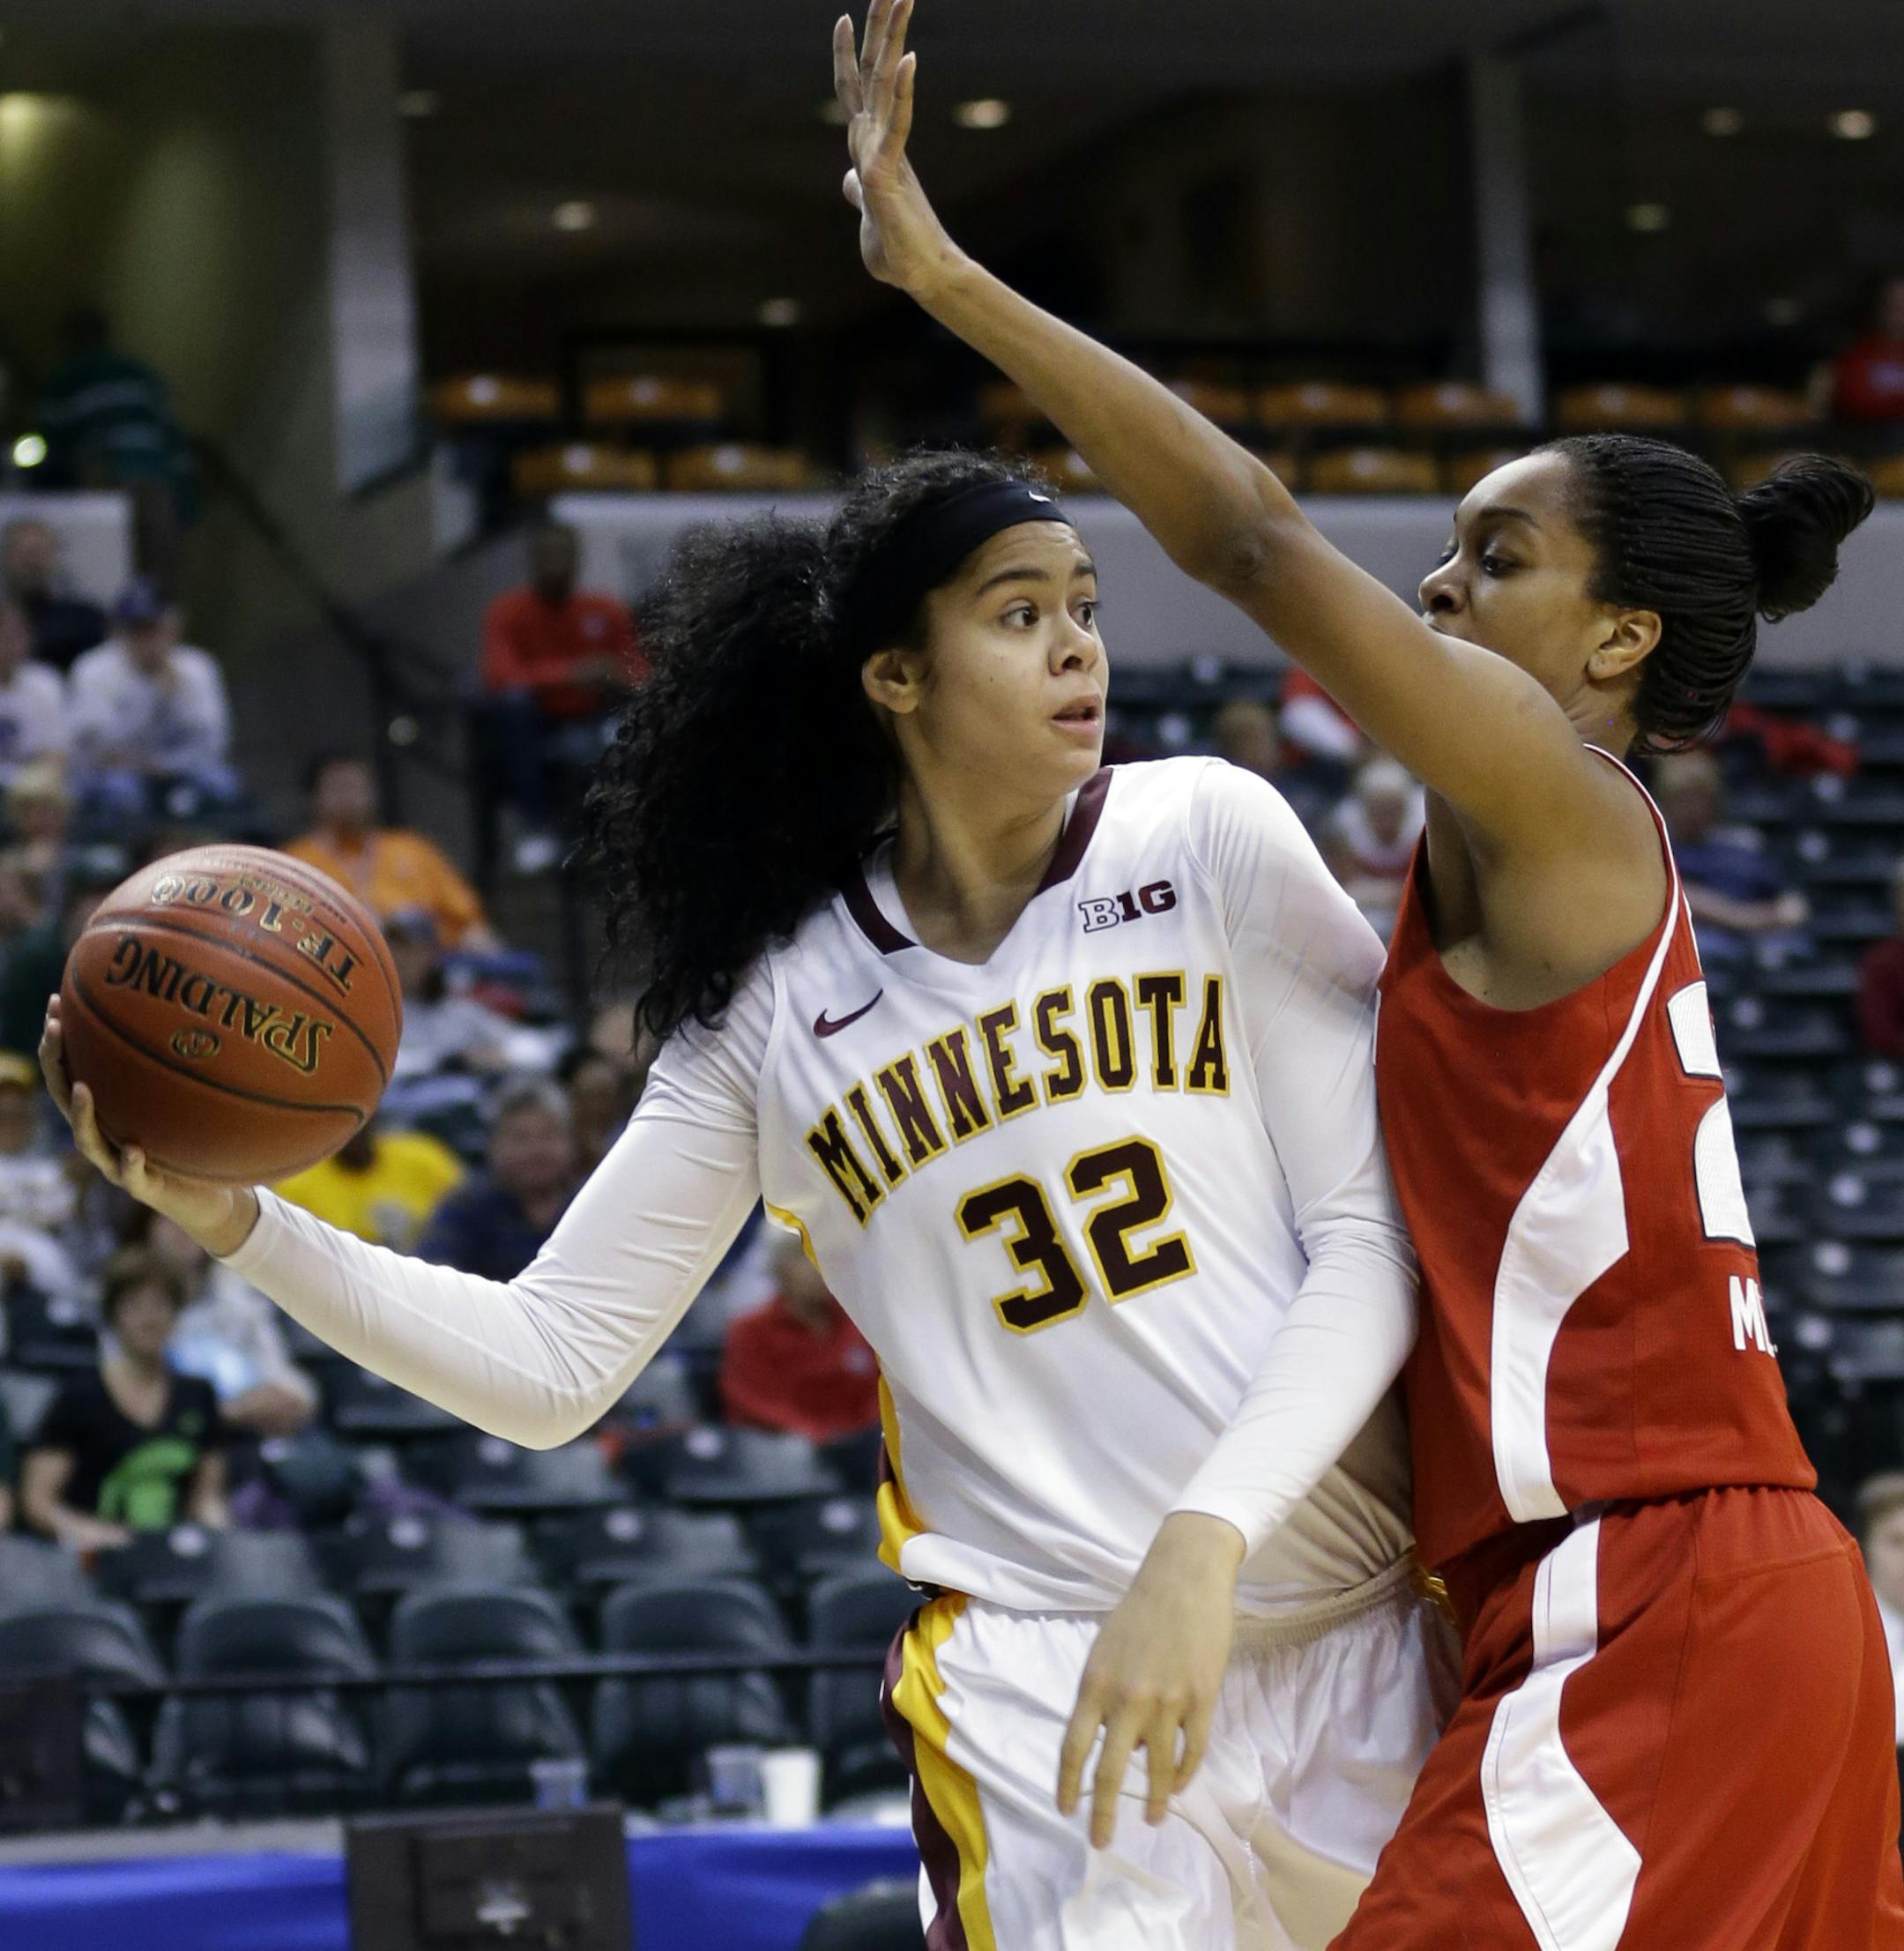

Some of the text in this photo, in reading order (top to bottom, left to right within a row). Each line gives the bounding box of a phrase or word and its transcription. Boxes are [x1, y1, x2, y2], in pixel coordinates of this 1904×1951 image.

[104, 936, 334, 1076] SPALDING
[151, 875, 357, 991] TF-1000
[804, 969, 1231, 1229] MINNESOTA
[954, 1134, 1198, 1335] 32
